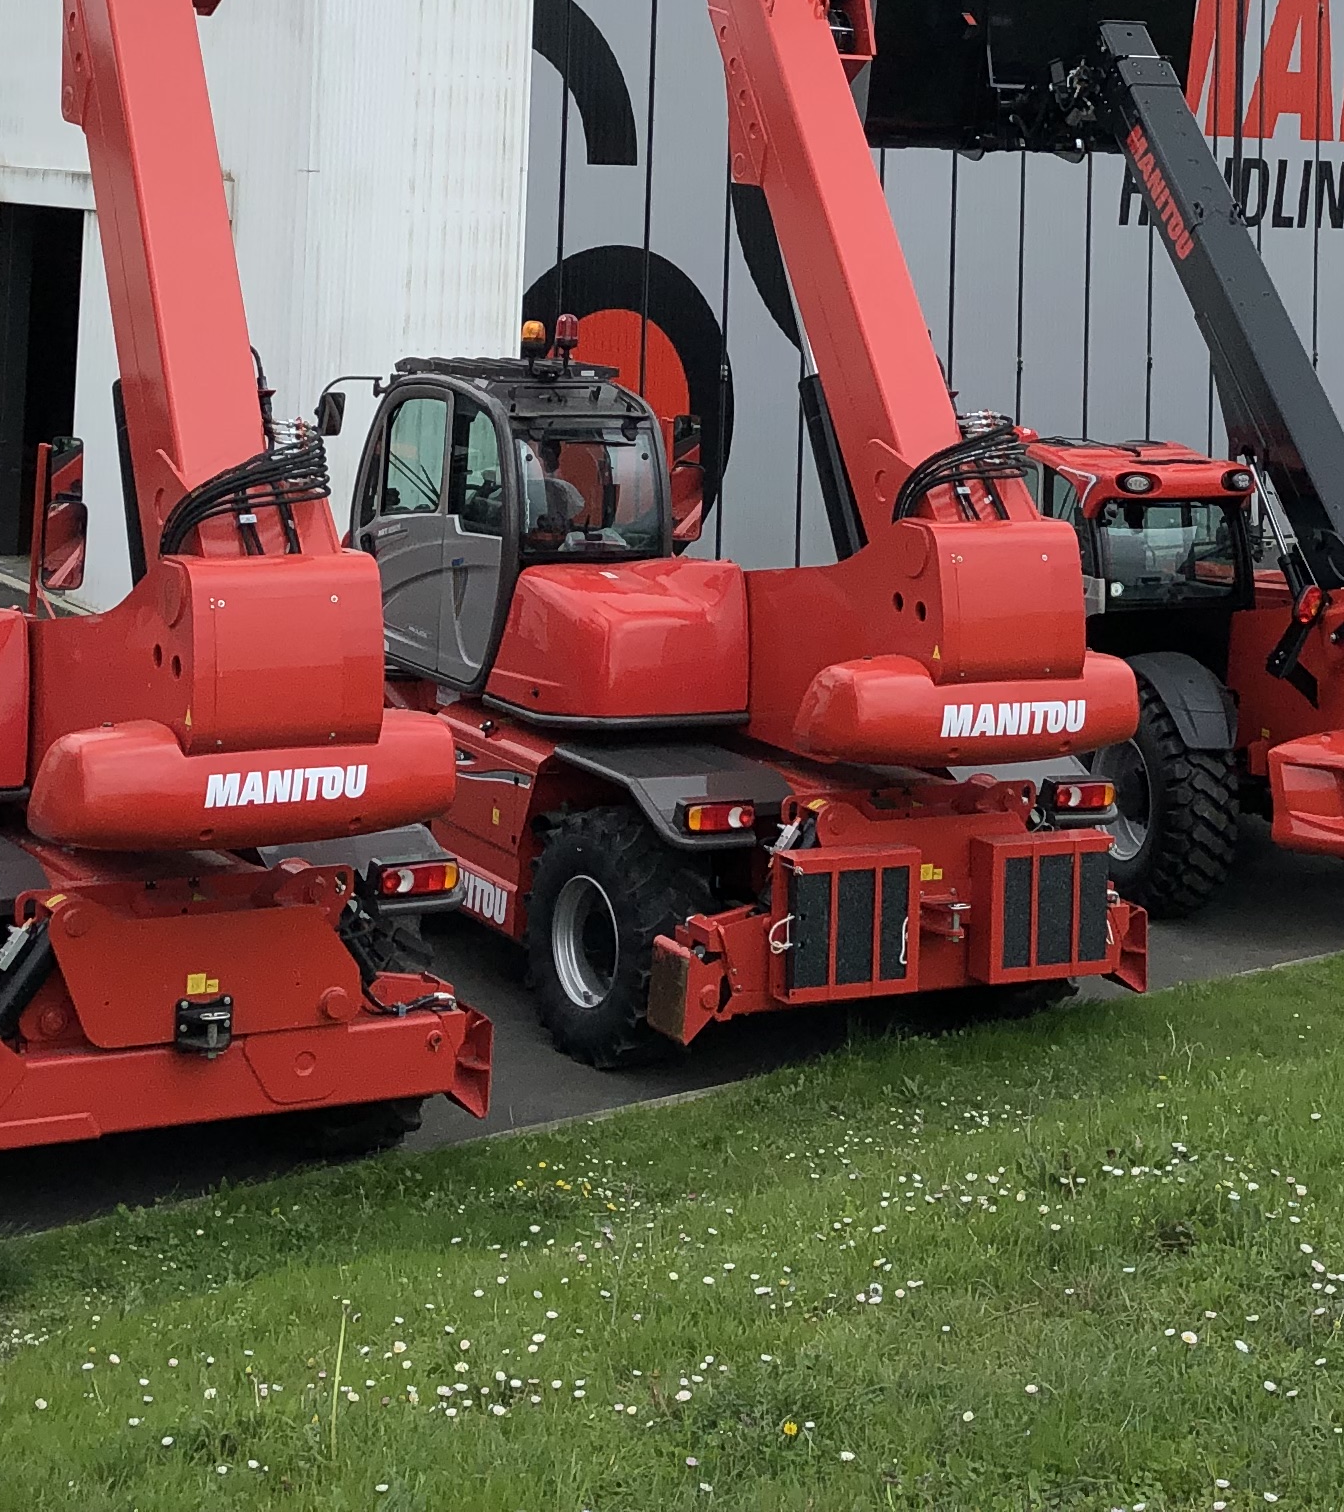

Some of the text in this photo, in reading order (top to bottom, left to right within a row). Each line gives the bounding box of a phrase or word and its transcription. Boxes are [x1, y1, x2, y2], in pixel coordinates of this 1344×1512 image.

[1127, 124, 1194, 260] MANITOU
[940, 699, 1087, 738] MANITOU
[204, 764, 369, 809] MANITOU
